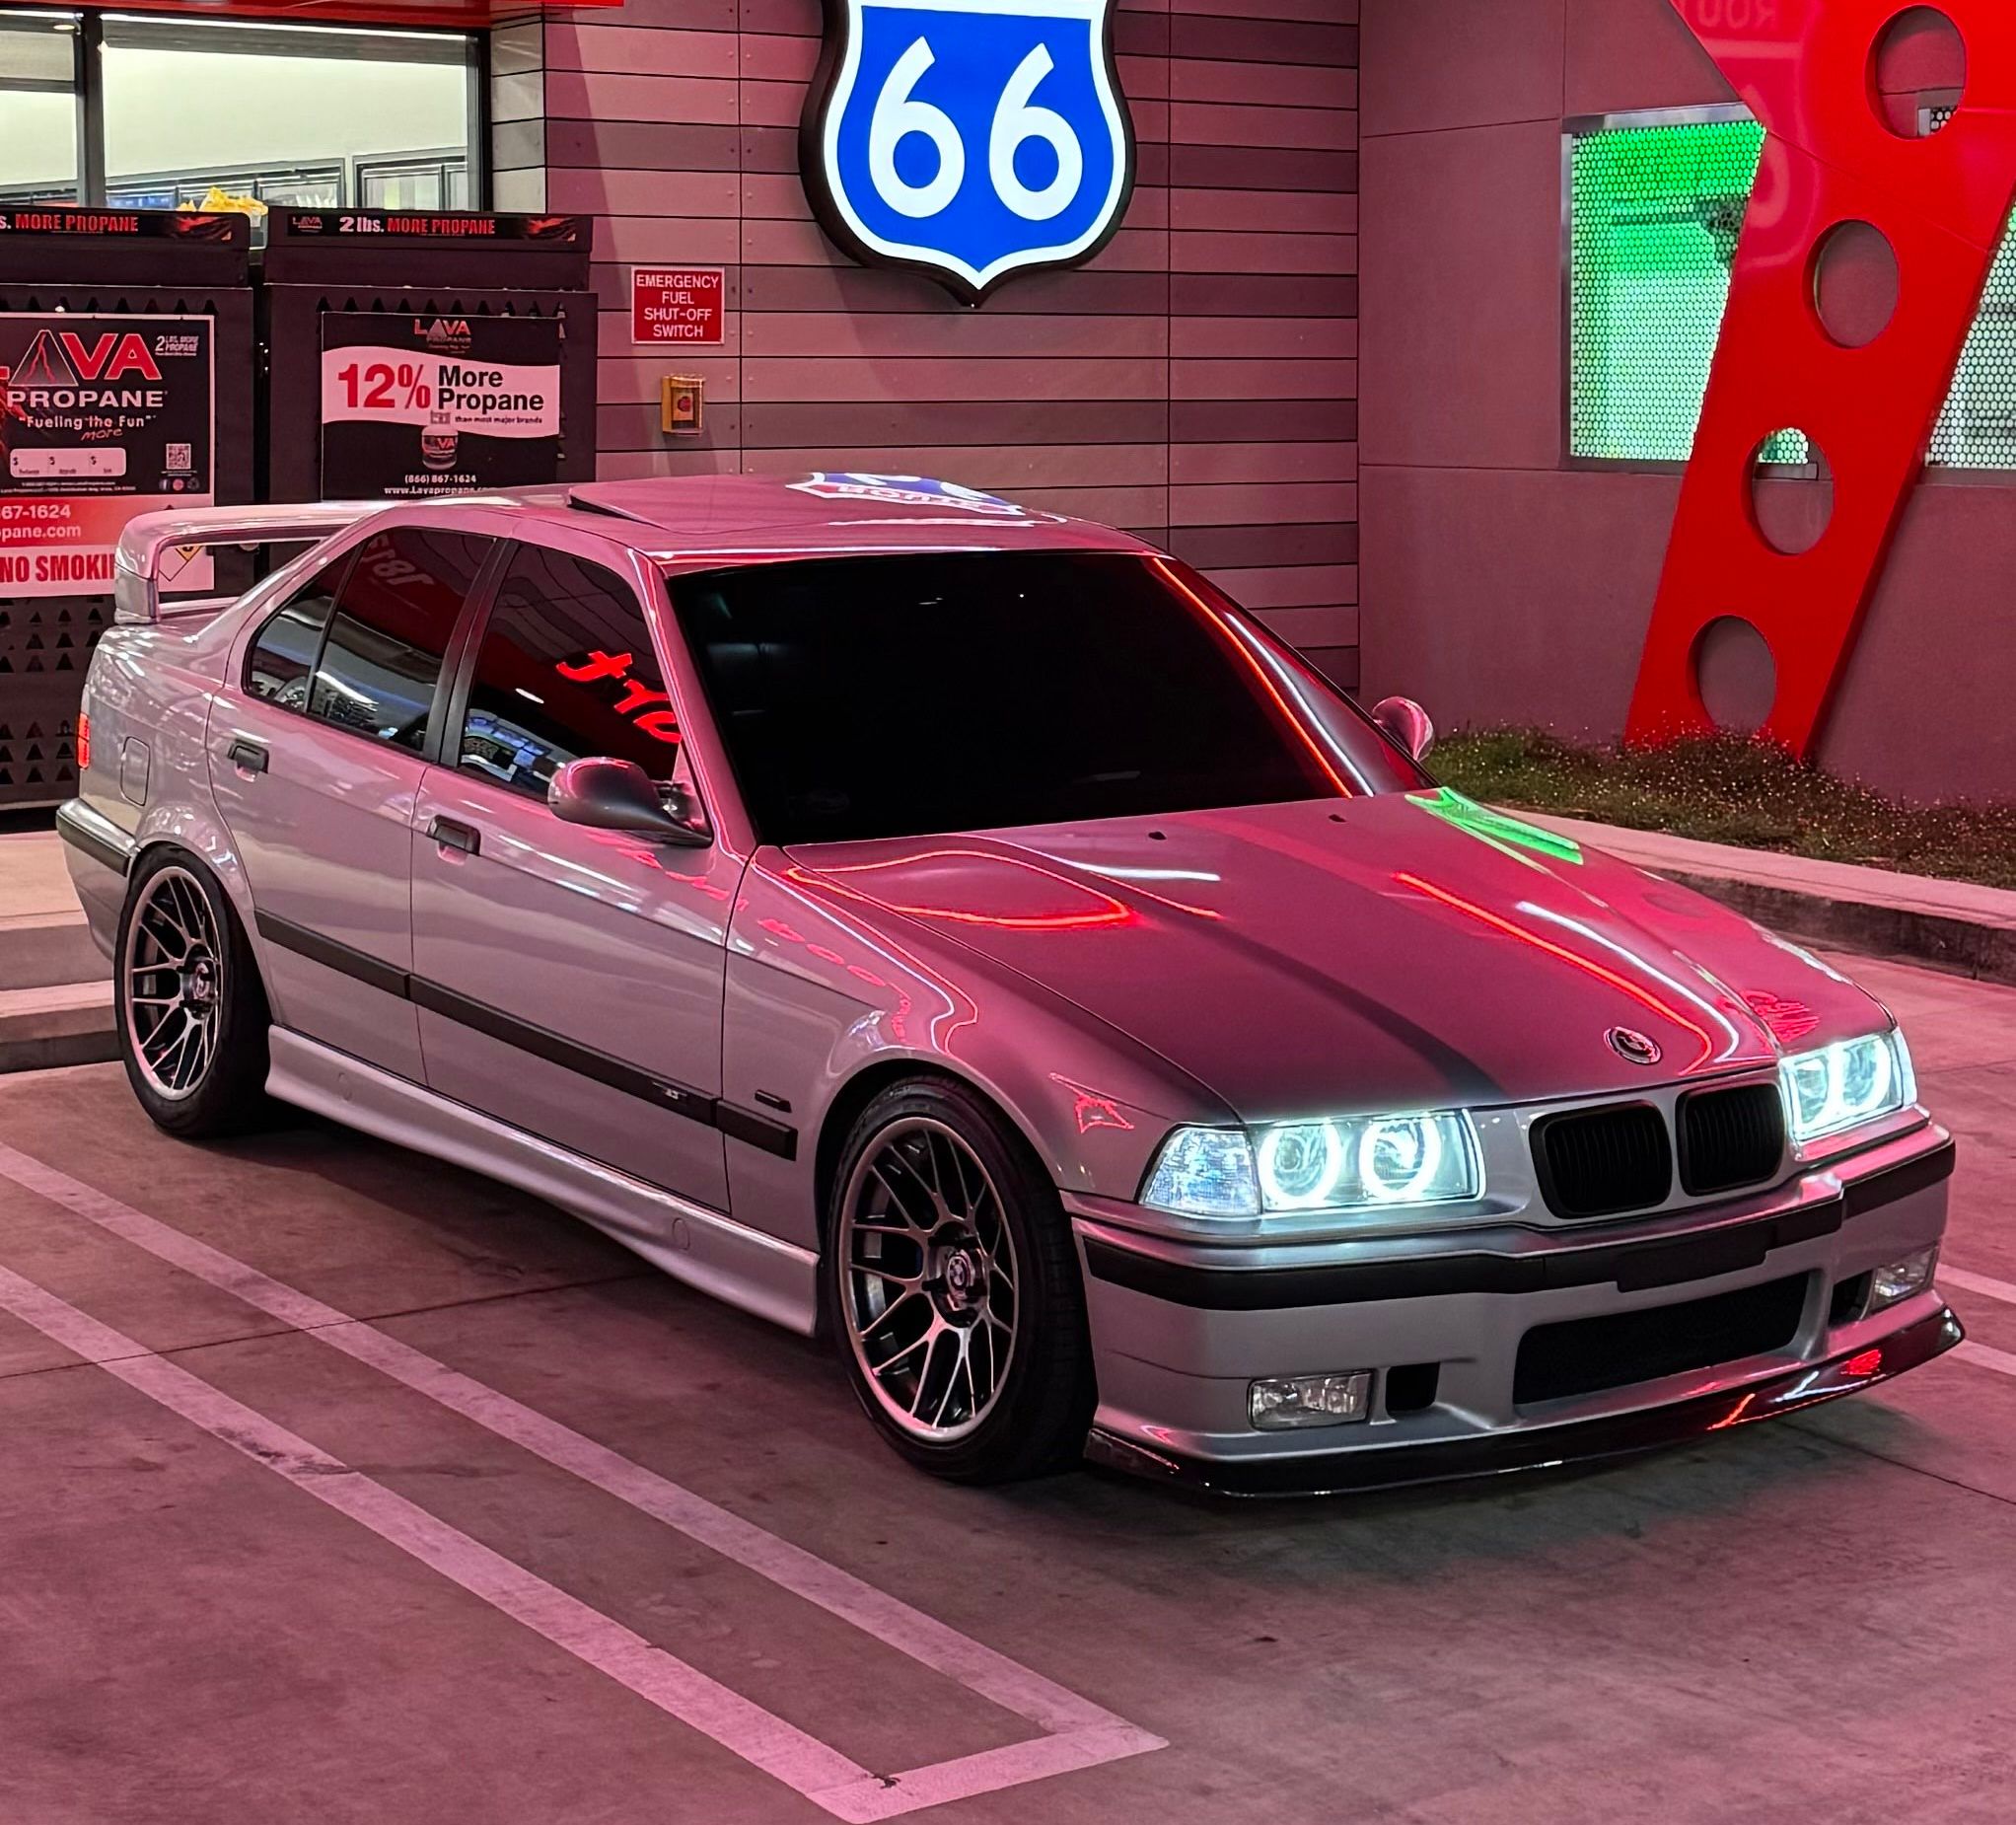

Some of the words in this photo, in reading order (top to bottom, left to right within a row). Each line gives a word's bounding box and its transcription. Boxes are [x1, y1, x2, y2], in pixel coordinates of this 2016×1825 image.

[869, 36, 1083, 221] 66
[15, 213, 61, 229] MORE
[65, 214, 138, 232] PROPANE
[339, 216, 354, 232] 2
[357, 217, 384, 232] lbs.
[388, 218, 427, 233] MORE
[432, 219, 495, 234] PROPANE
[636, 274, 719, 288] EMERGENCY
[662, 291, 694, 304] FUEL
[644, 308, 712, 321] SHUT-OFF
[414, 319, 470, 338] LAVA
[653, 325, 703, 337] SWITCH
[0, 329, 163, 386] AVA
[338, 364, 431, 408] 12%
[439, 365, 503, 388] More
[7, 390, 164, 407] PROPANE
[438, 389, 544, 414] Propane
[81, 428, 123, 441] more
[404, 474, 430, 484] (866)
[431, 474, 476, 483] 867-1624
[0, 505, 71, 519] 67-1624
[0, 526, 81, 543] pane.com
[0, 555, 30, 582] NO
